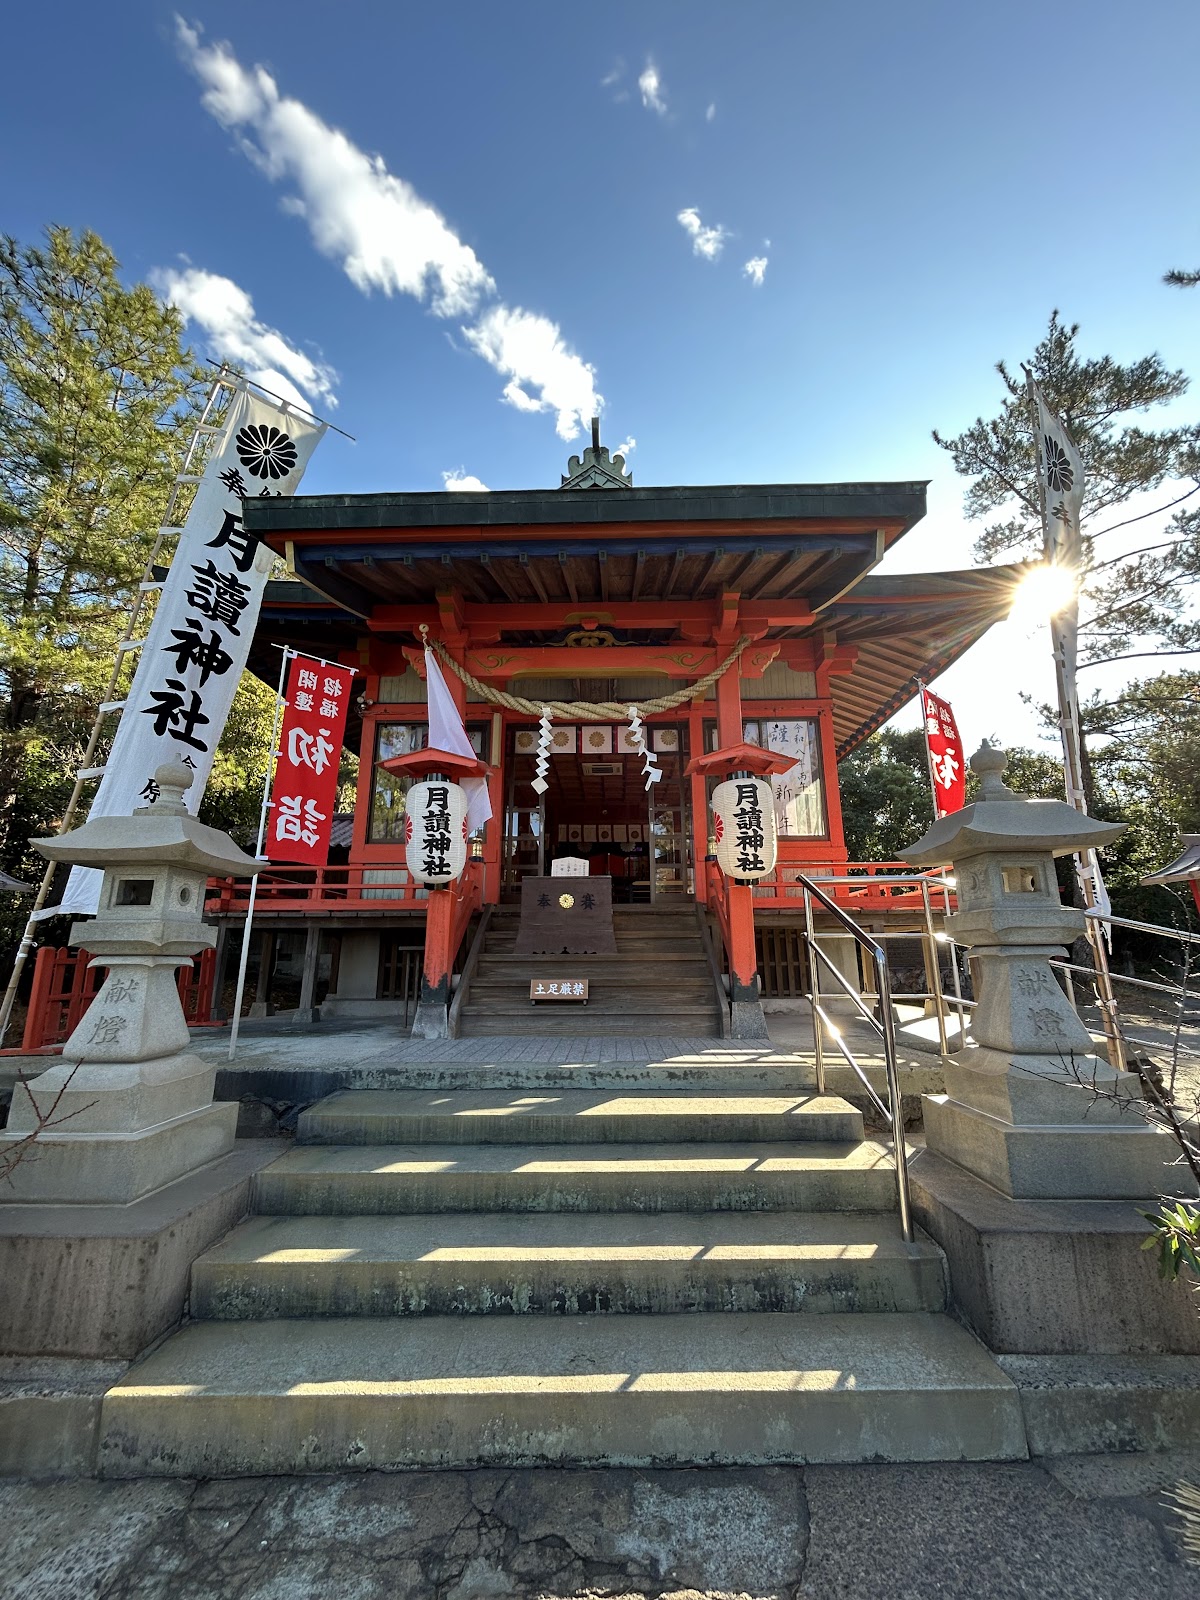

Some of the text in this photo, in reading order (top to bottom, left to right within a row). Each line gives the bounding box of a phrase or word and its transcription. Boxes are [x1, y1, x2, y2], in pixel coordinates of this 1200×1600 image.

[140, 508, 260, 753] 月讀神社
[771, 724, 794, 832] 謹新年
[420, 786, 452, 877] 月讀神社
[733, 783, 766, 872] 月讀神社
[534, 982, 585, 996] 土足厳禁
